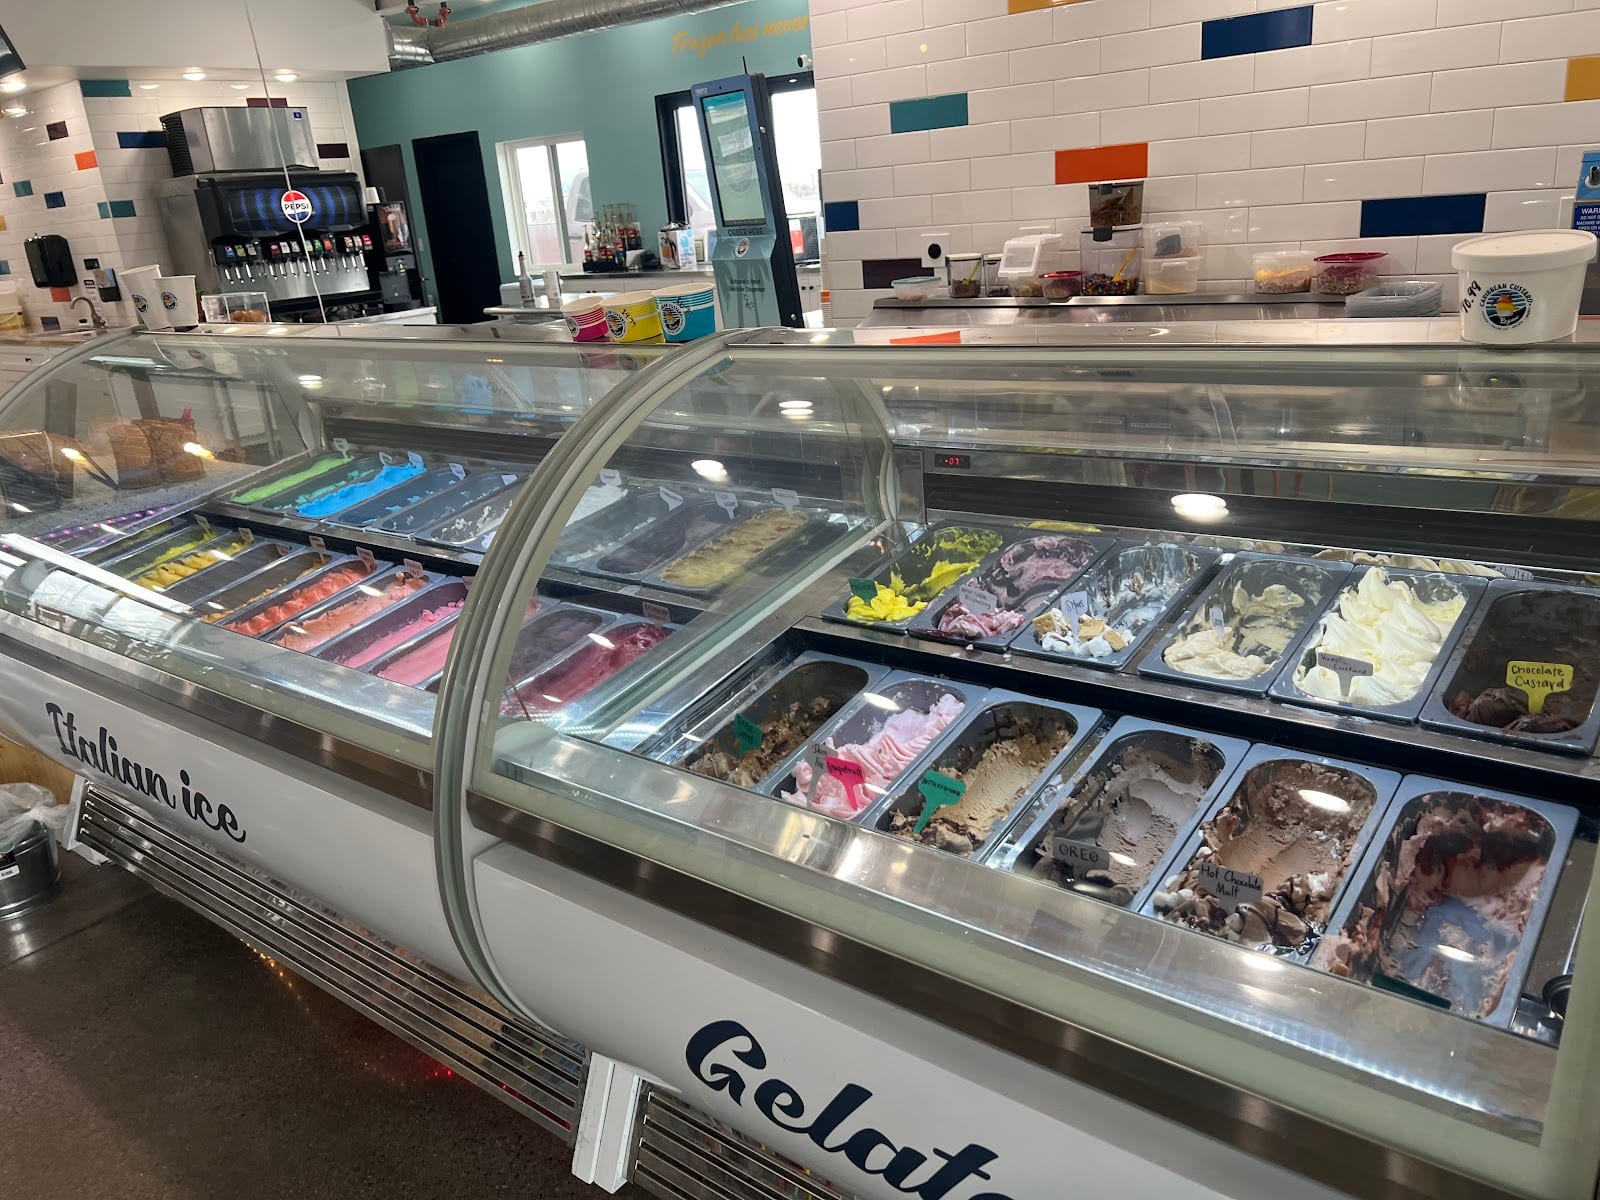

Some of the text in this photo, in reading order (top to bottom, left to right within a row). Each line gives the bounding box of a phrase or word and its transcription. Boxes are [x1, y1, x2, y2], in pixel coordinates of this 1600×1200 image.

[284, 202, 310, 210] PEPSI
[1462, 280, 1482, 314] 10.99
[1509, 283, 1534, 304] CUSTARD
[1511, 664, 1565, 677] Chocolate
[1514, 675, 1565, 690] Custard
[45, 702, 247, 843] Italian ice
[1059, 843, 1099, 863] OREO
[1201, 863, 1263, 892] Hot Chocolate
[1215, 882, 1240, 898] Malt
[685, 1019, 1016, 1200] Gelat
